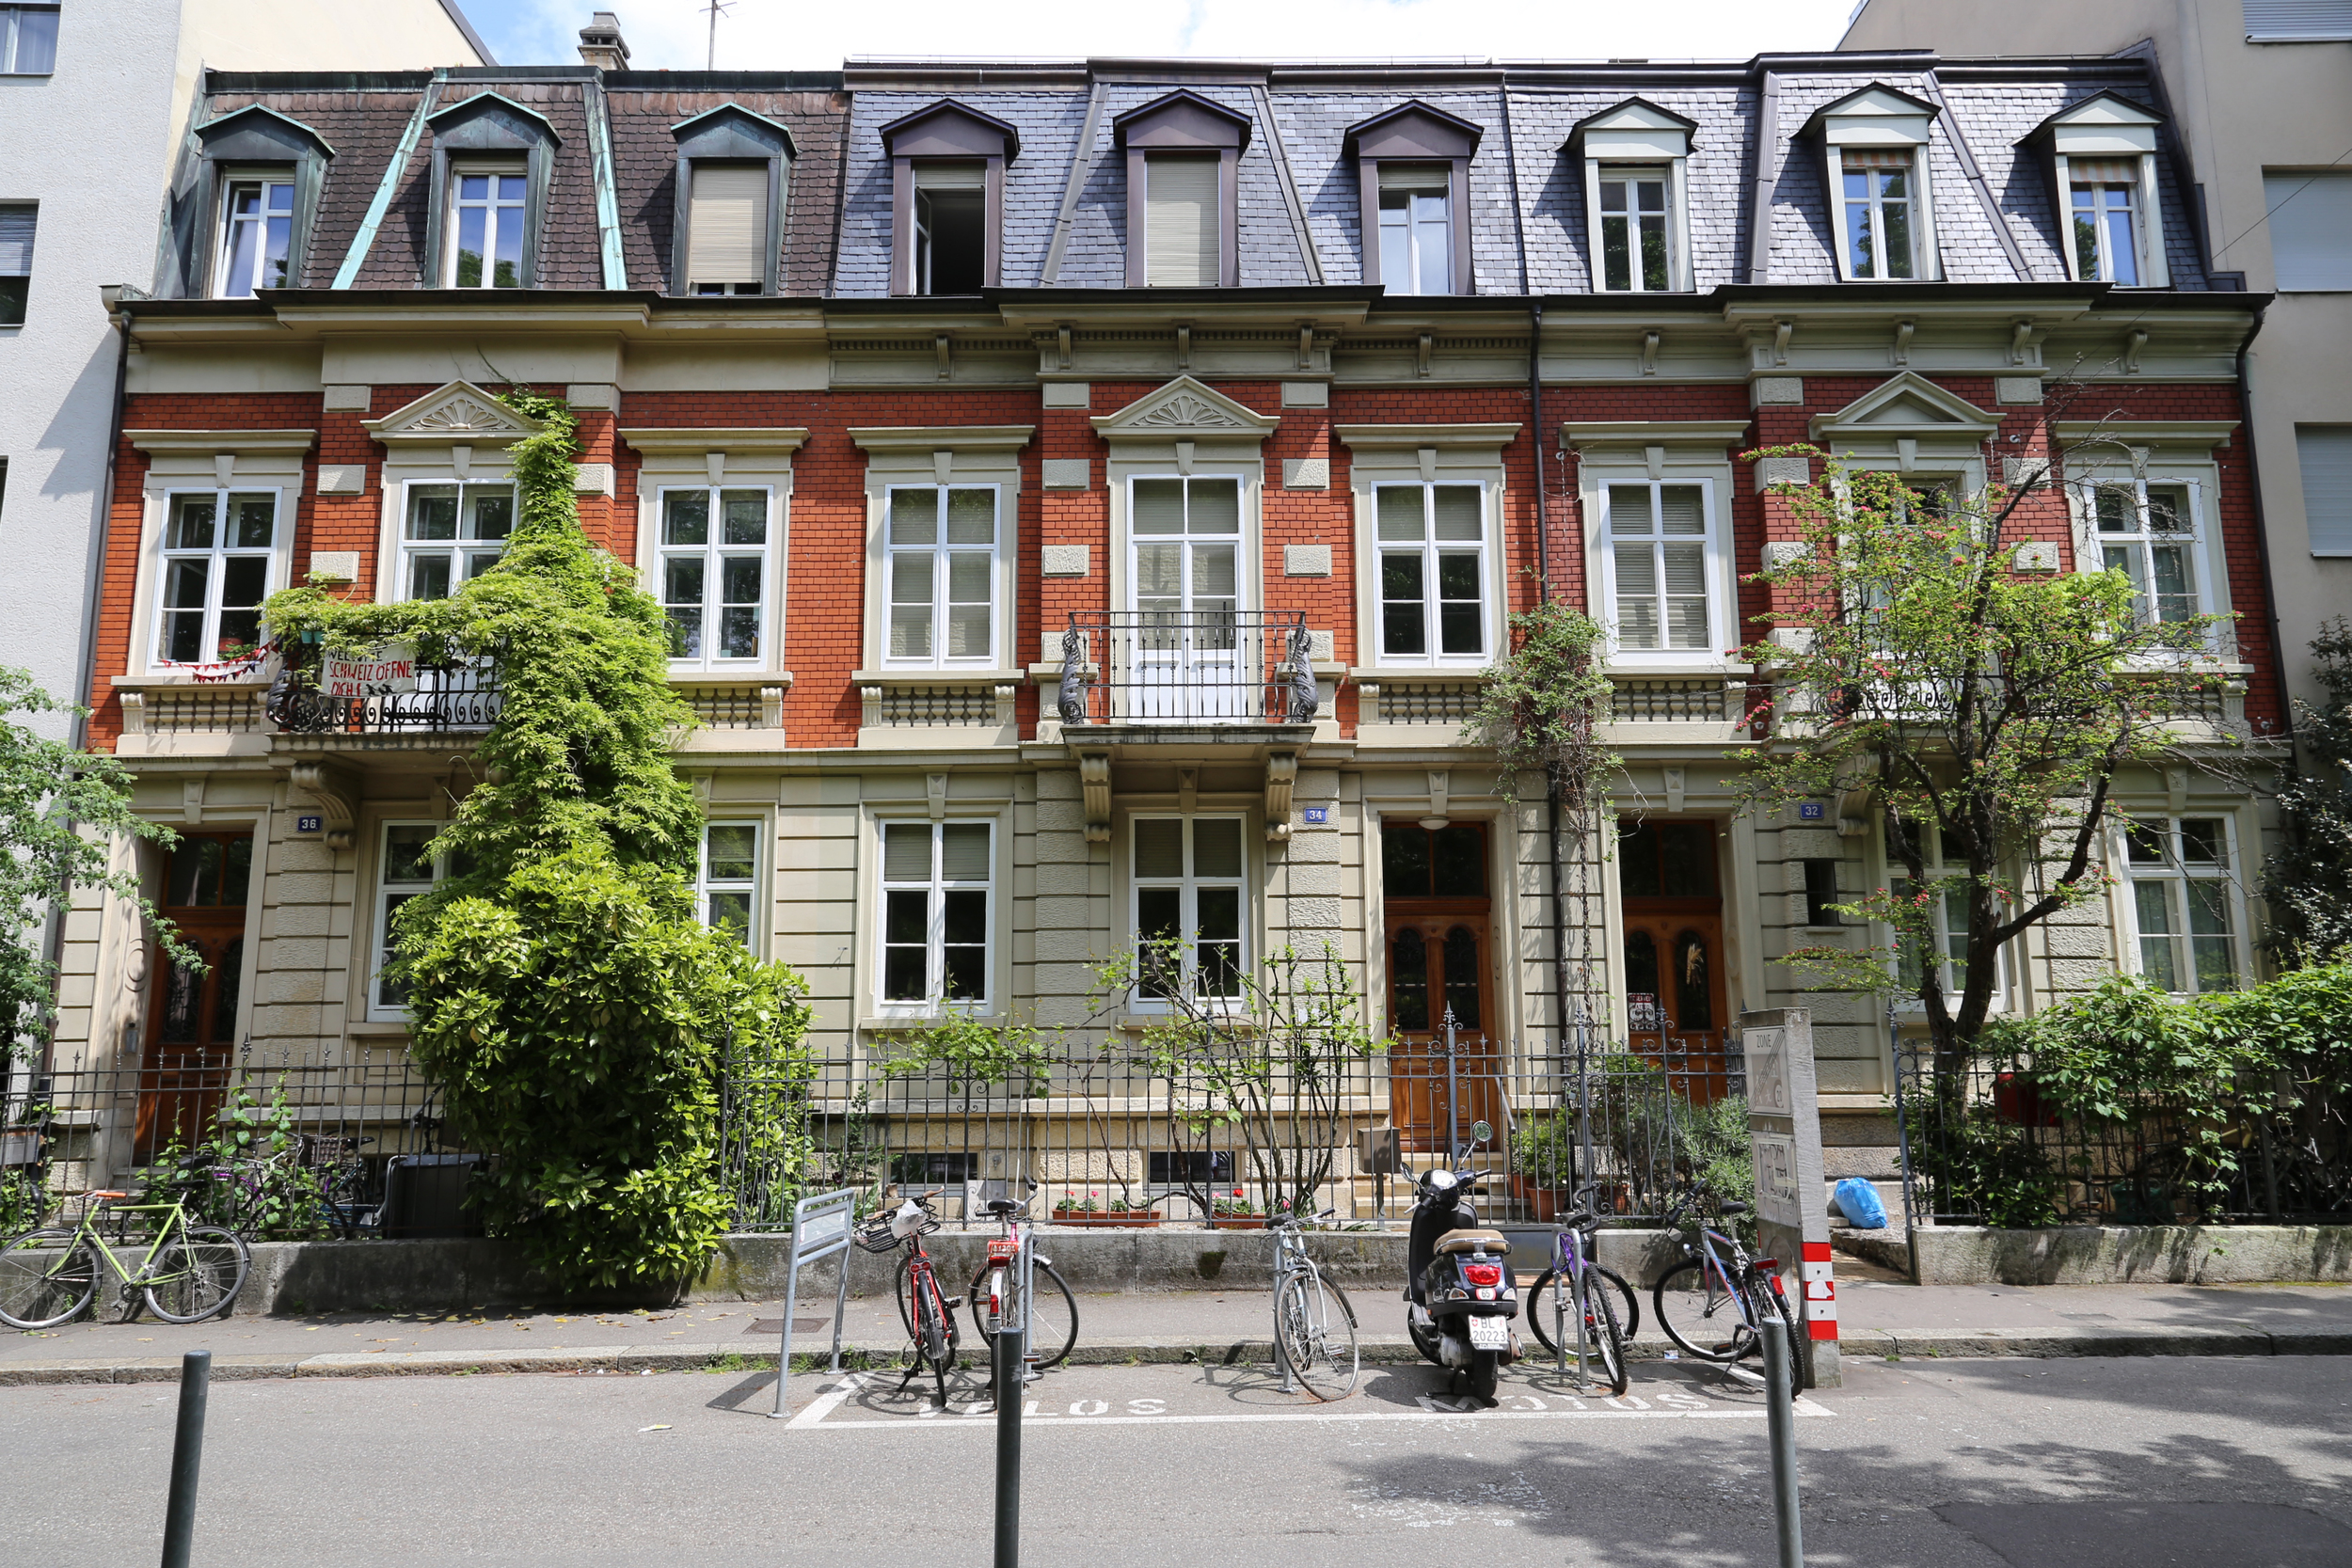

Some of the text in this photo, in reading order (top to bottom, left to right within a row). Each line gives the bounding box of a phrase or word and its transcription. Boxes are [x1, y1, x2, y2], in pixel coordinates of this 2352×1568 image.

[329, 660, 413, 681] SCHWEIZ ÖFFNE
[1309, 810, 1323, 820] 34
[1804, 806, 1819, 816] 32
[301, 818, 317, 829] 36
[1756, 1034, 1772, 1048] ZONE
[1481, 1289, 1490, 1298] 65
[1481, 1318, 1495, 1329] BL
[1472, 1330, 1506, 1342] 20223
